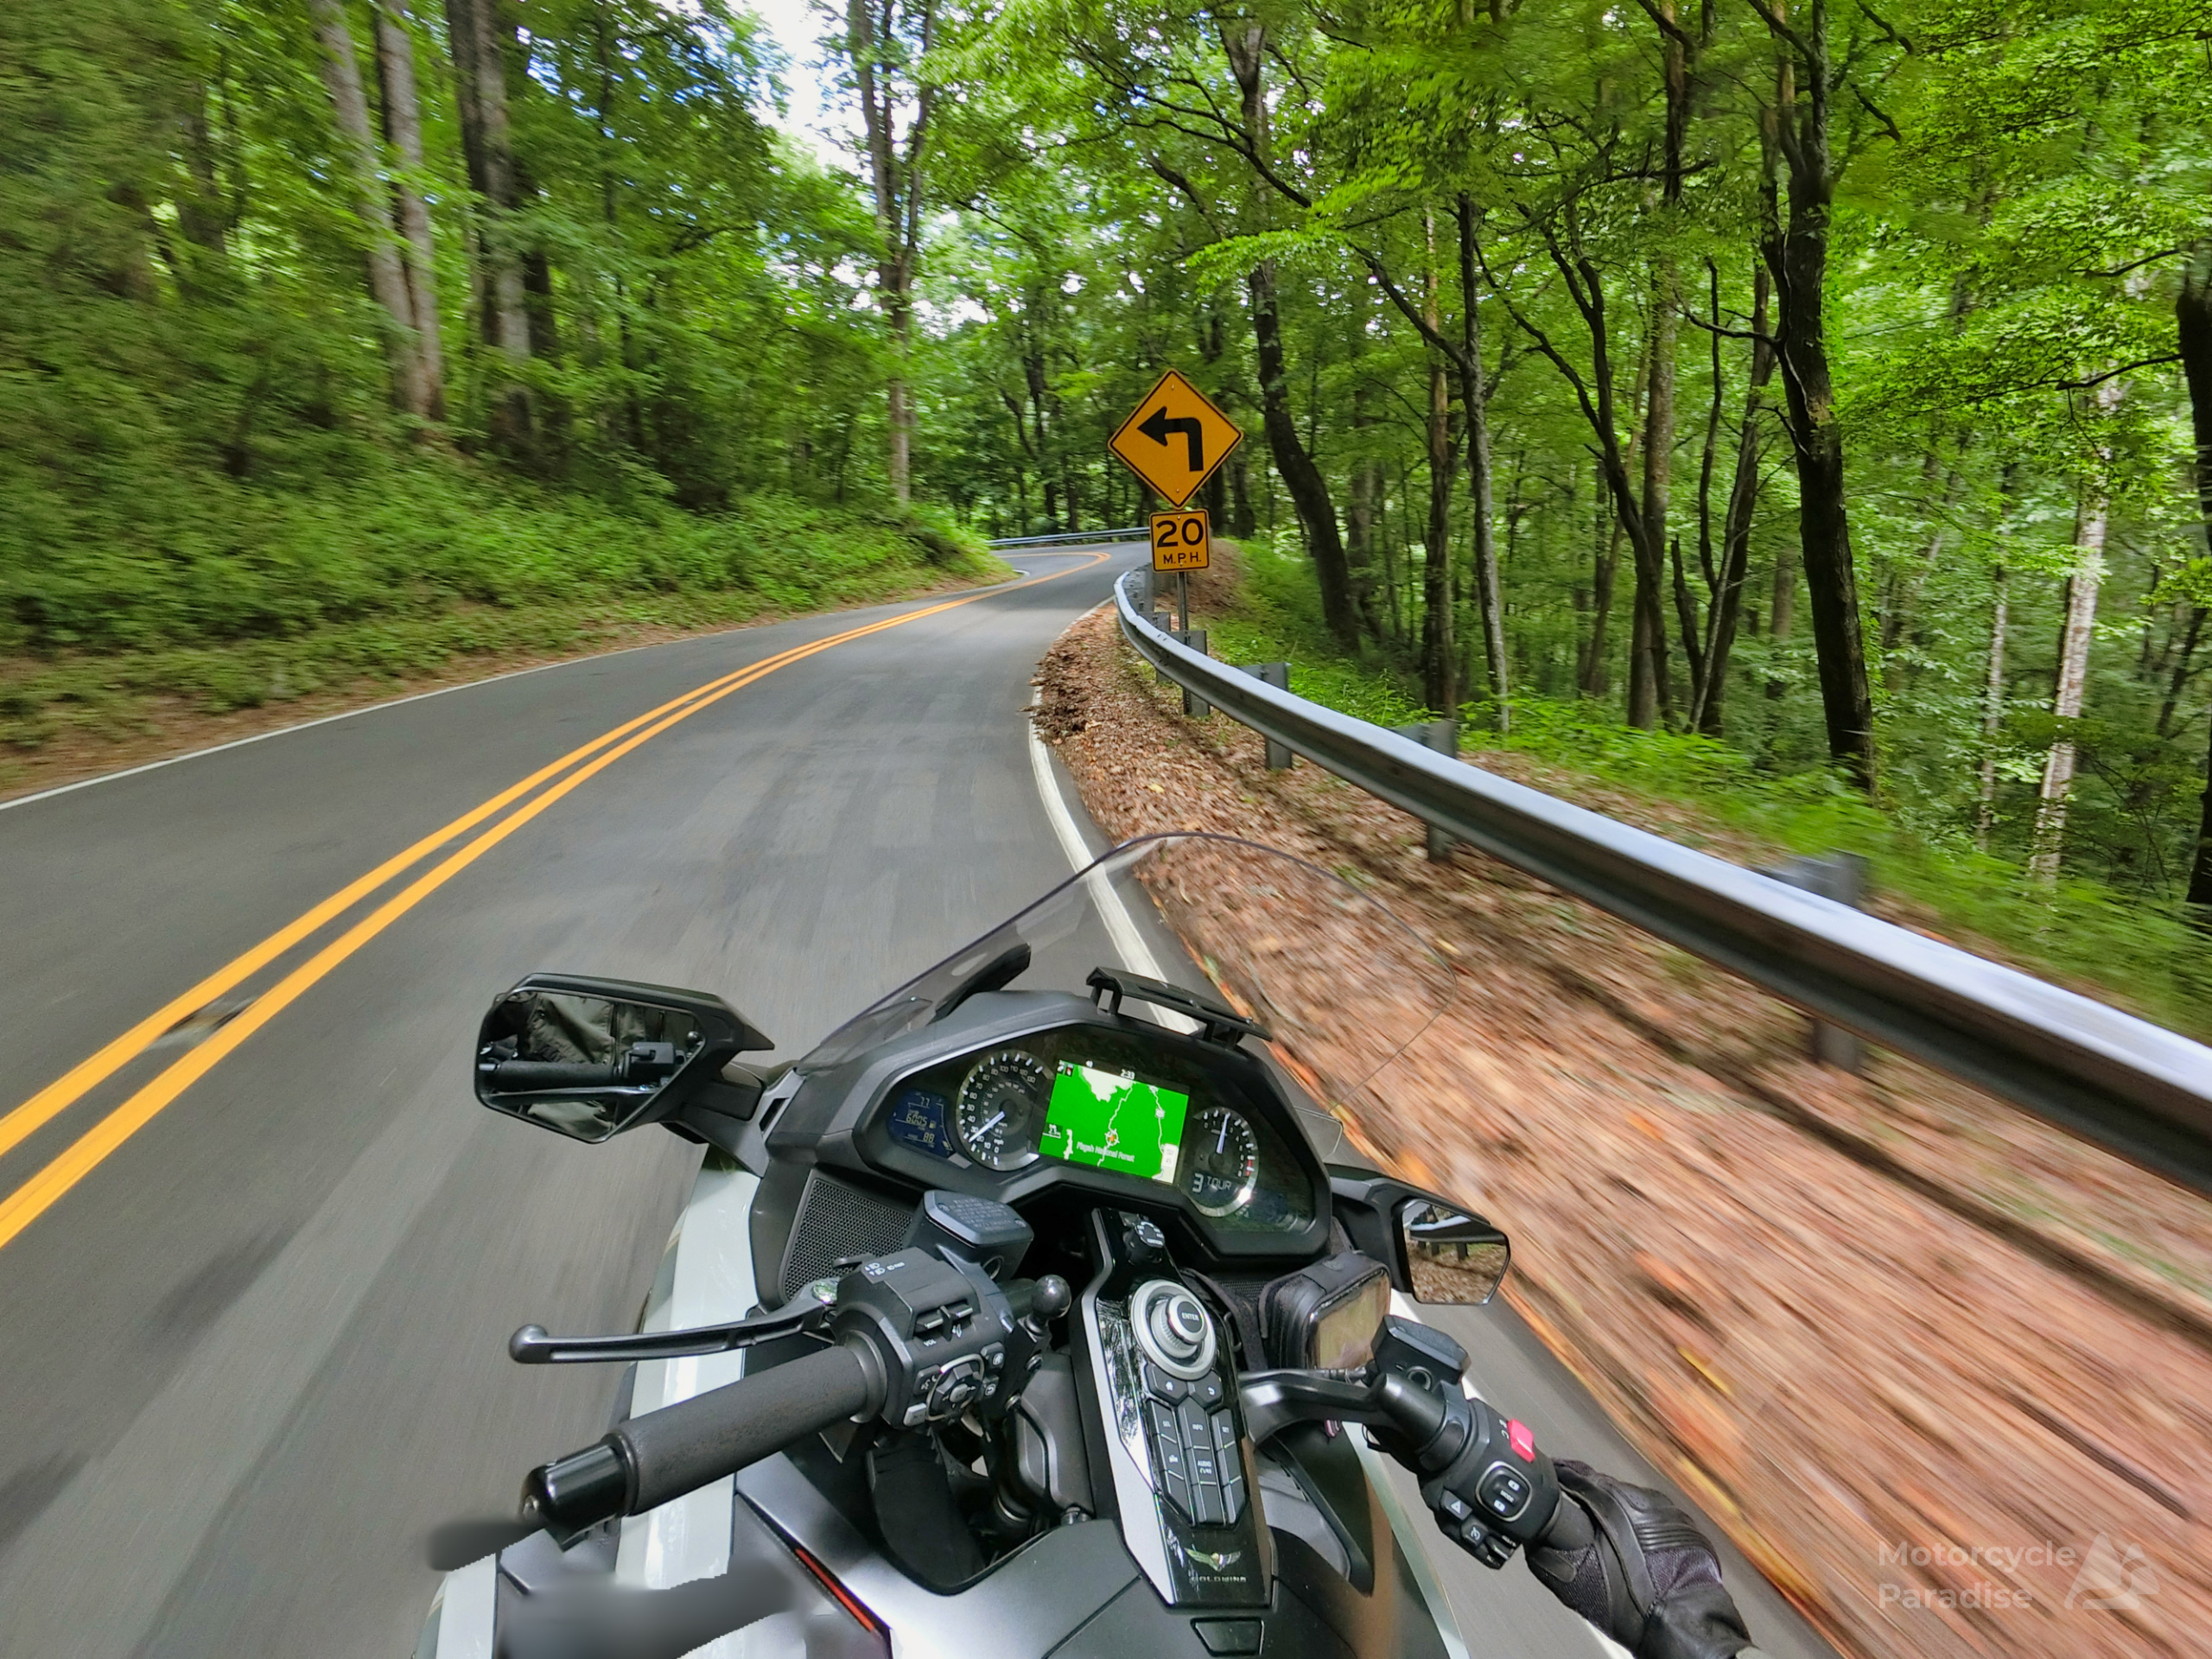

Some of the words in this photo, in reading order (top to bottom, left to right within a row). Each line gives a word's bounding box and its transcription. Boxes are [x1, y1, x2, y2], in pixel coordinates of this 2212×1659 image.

[1155, 518, 1204, 548] 20
[1163, 551, 1202, 564] M.P.H.
[1192, 1173, 1205, 1192] 3
[1207, 1176, 1232, 1191] TOUR
[1181, 1313, 1200, 1321] ENTER
[924, 1338, 937, 1347] VOL
